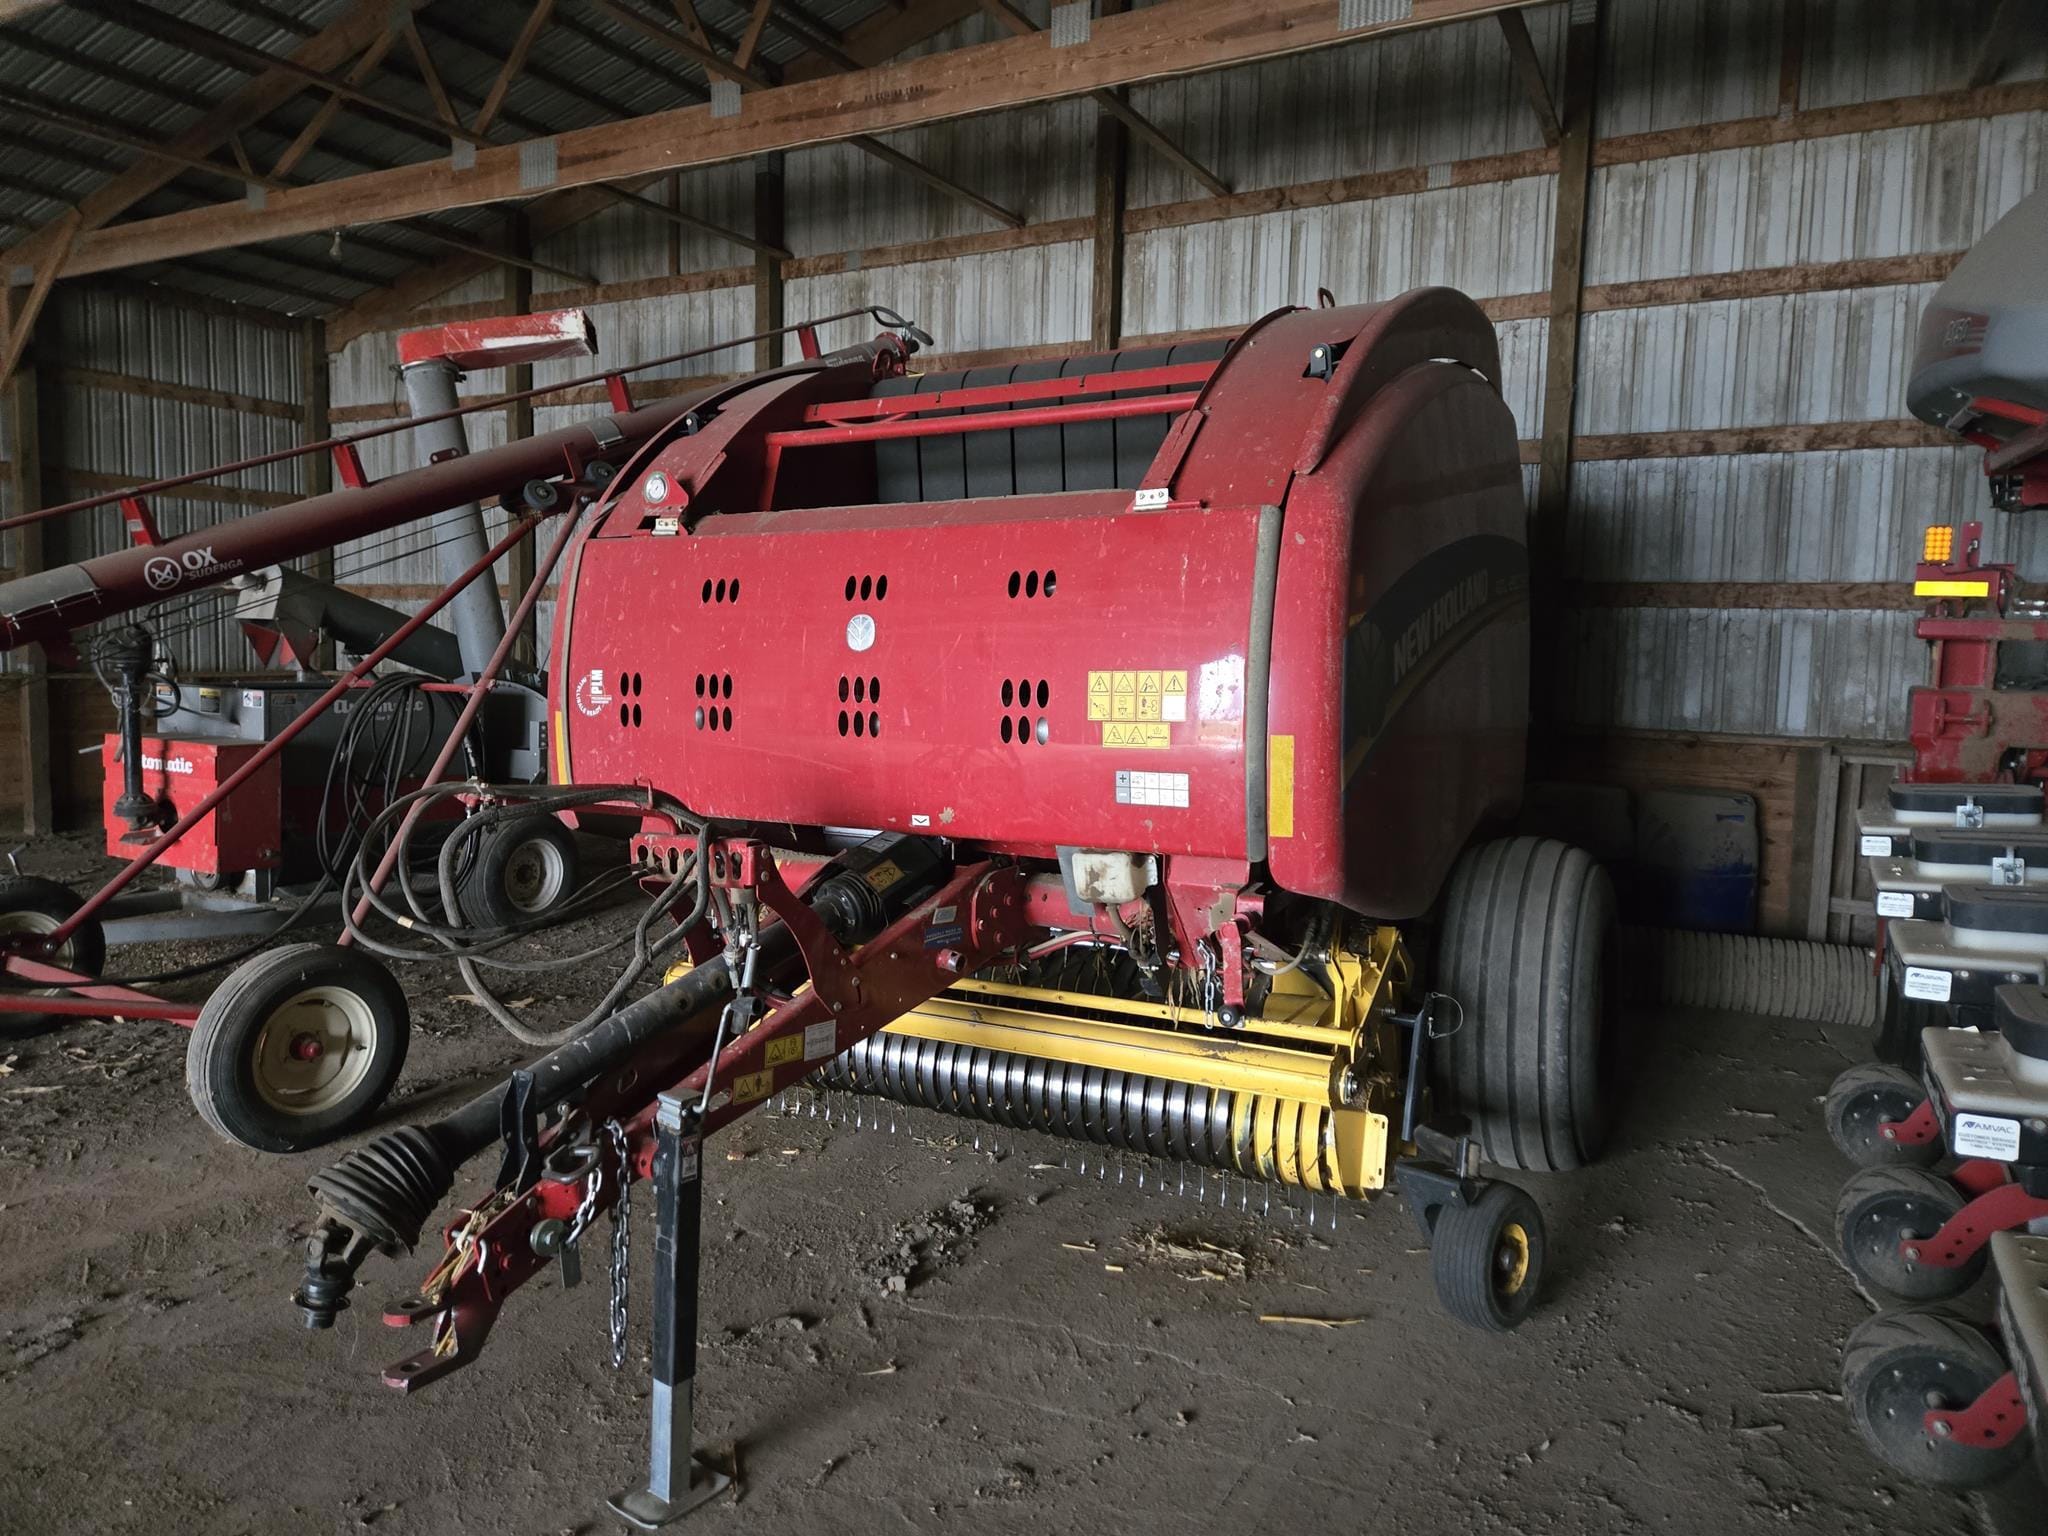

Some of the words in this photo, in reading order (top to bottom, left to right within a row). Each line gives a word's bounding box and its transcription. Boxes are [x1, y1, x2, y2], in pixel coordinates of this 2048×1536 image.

[182, 546, 218, 570] OX
[190, 559, 244, 581] SUDENGA
[1393, 607, 1432, 689] NEW
[1433, 568, 1489, 644] HOLLAND
[591, 669, 604, 695] PLM
[1974, 1122, 2014, 1134] AMVAC
